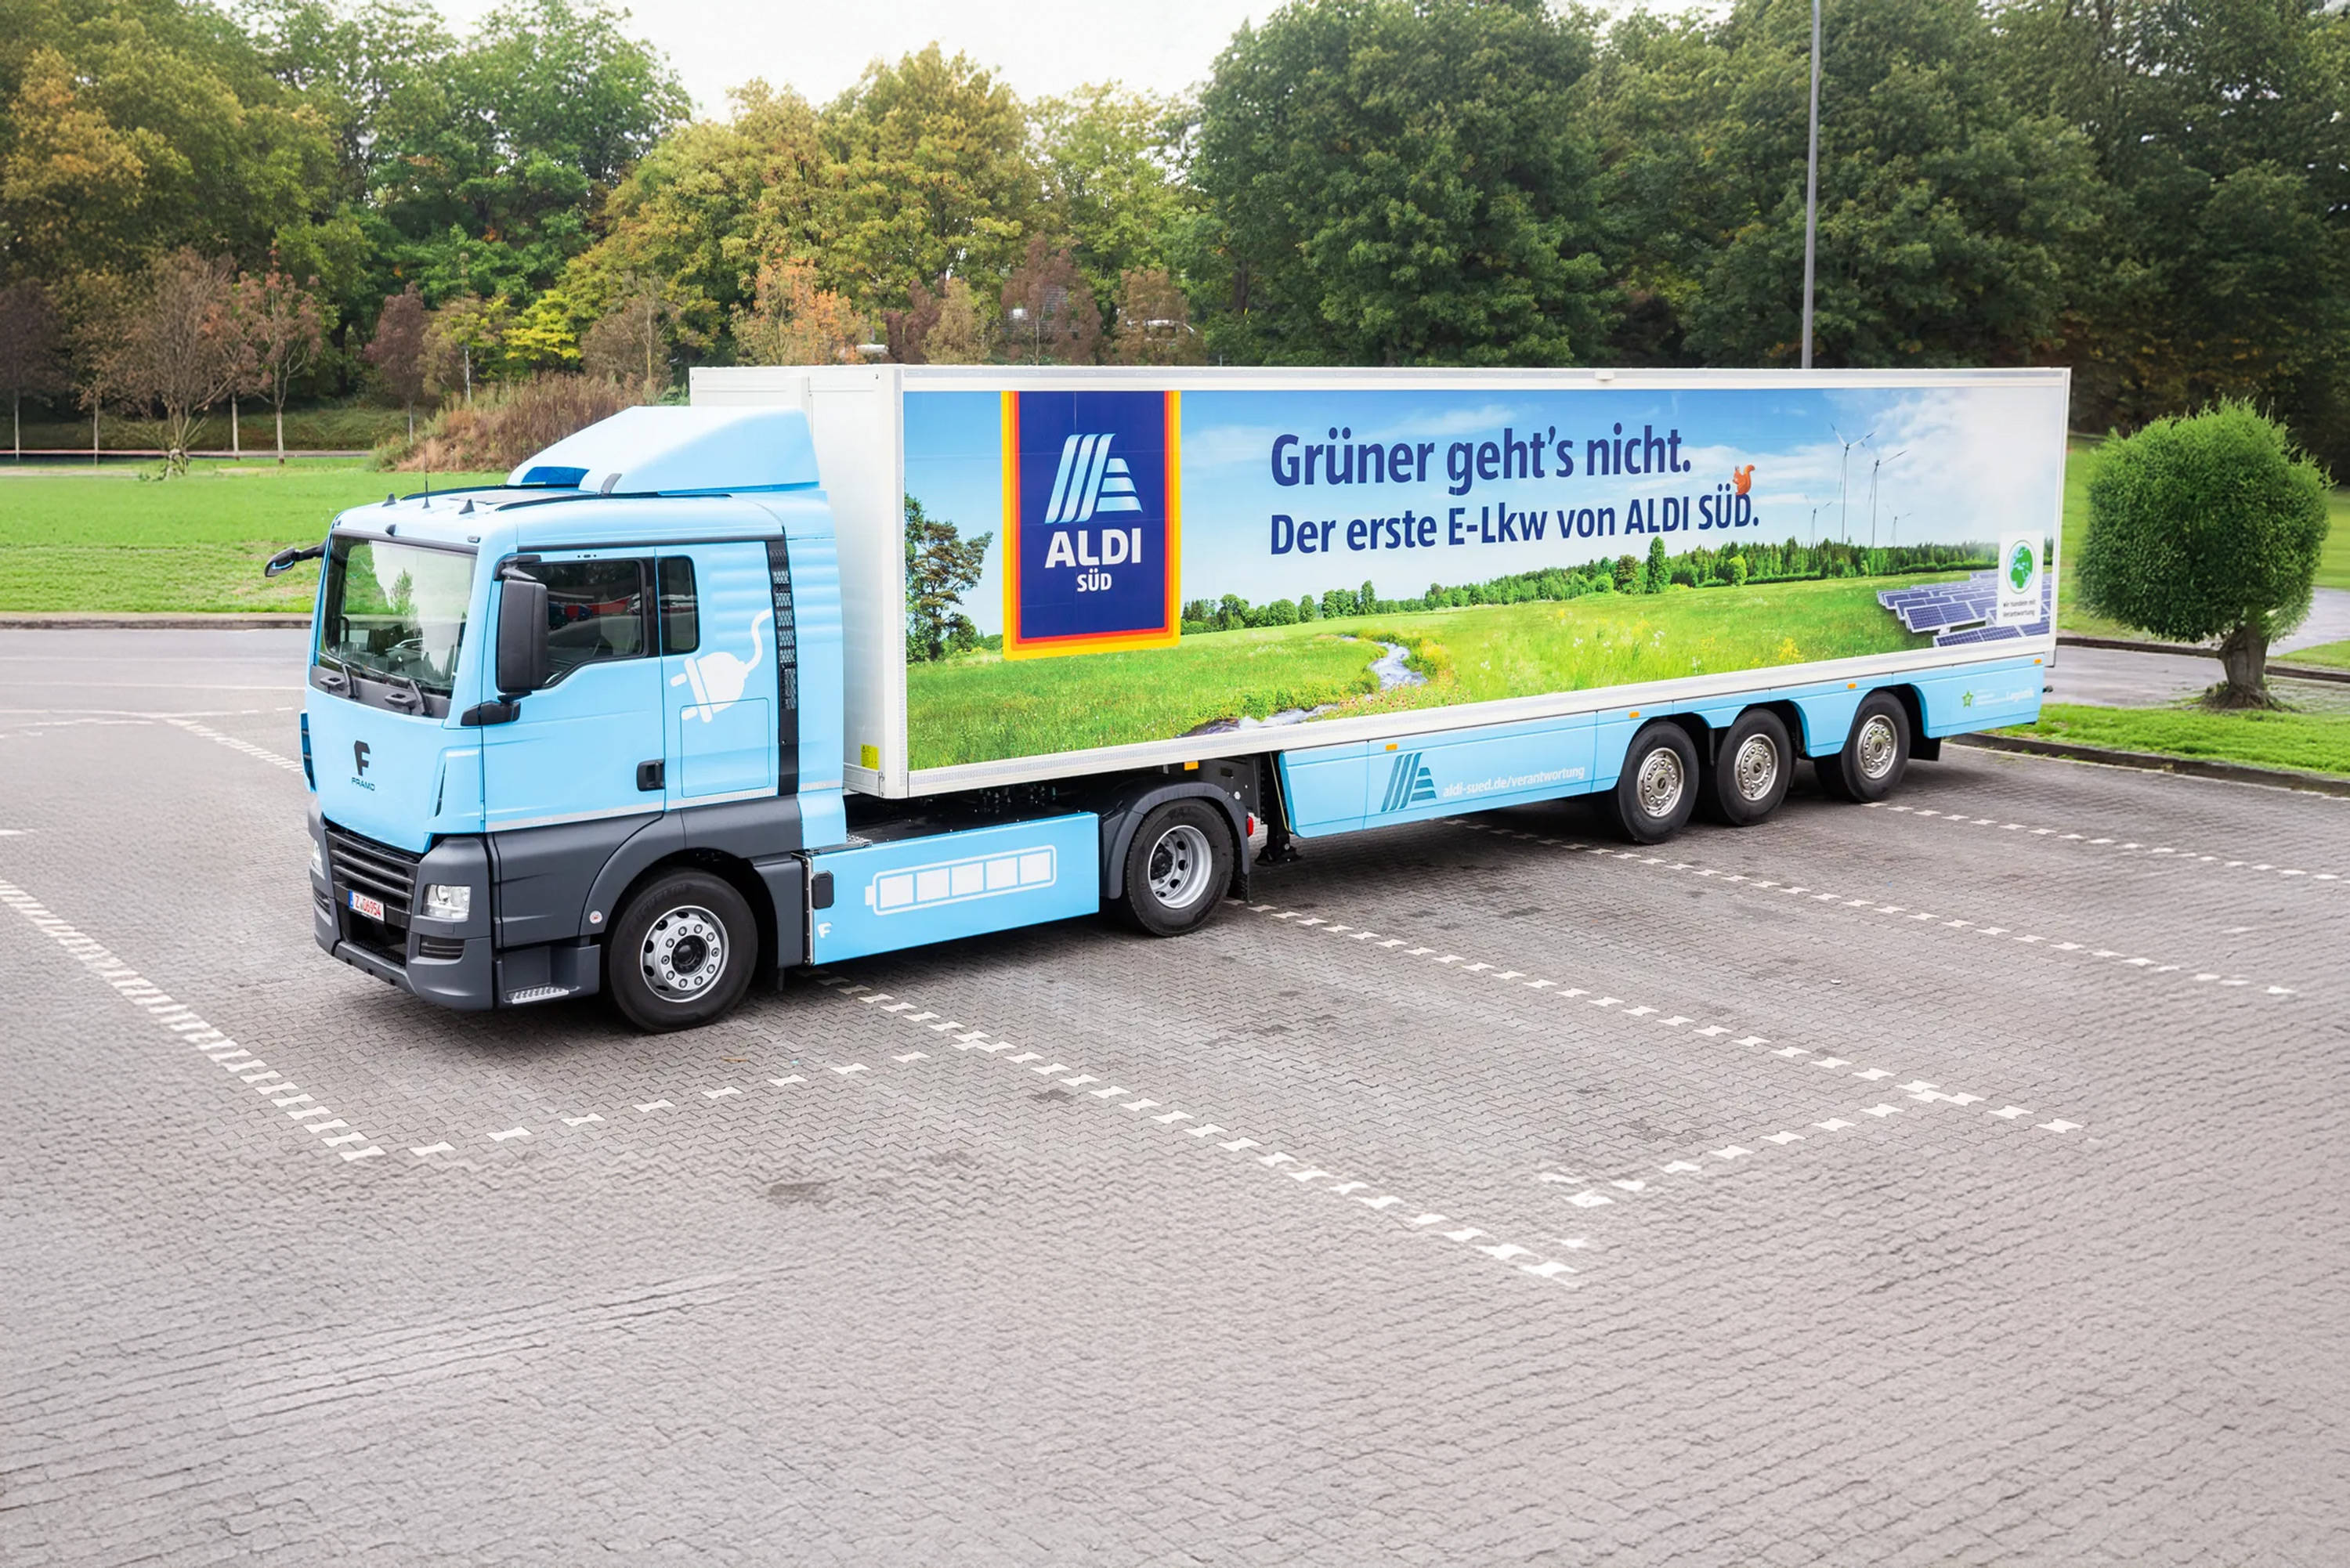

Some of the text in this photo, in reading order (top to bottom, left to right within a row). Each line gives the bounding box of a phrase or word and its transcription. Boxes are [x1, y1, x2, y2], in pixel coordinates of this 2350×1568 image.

[1271, 426, 1435, 487] Grüner
[1586, 422, 1691, 476] nicht.
[1271, 482, 1759, 555] Der erste E-Lkw von ALDI SÜD.
[1044, 527, 1141, 569] ALDI
[1076, 568, 1112, 592] SÜD
[1443, 766, 1585, 798] aldi-sued.de/verantwortung
